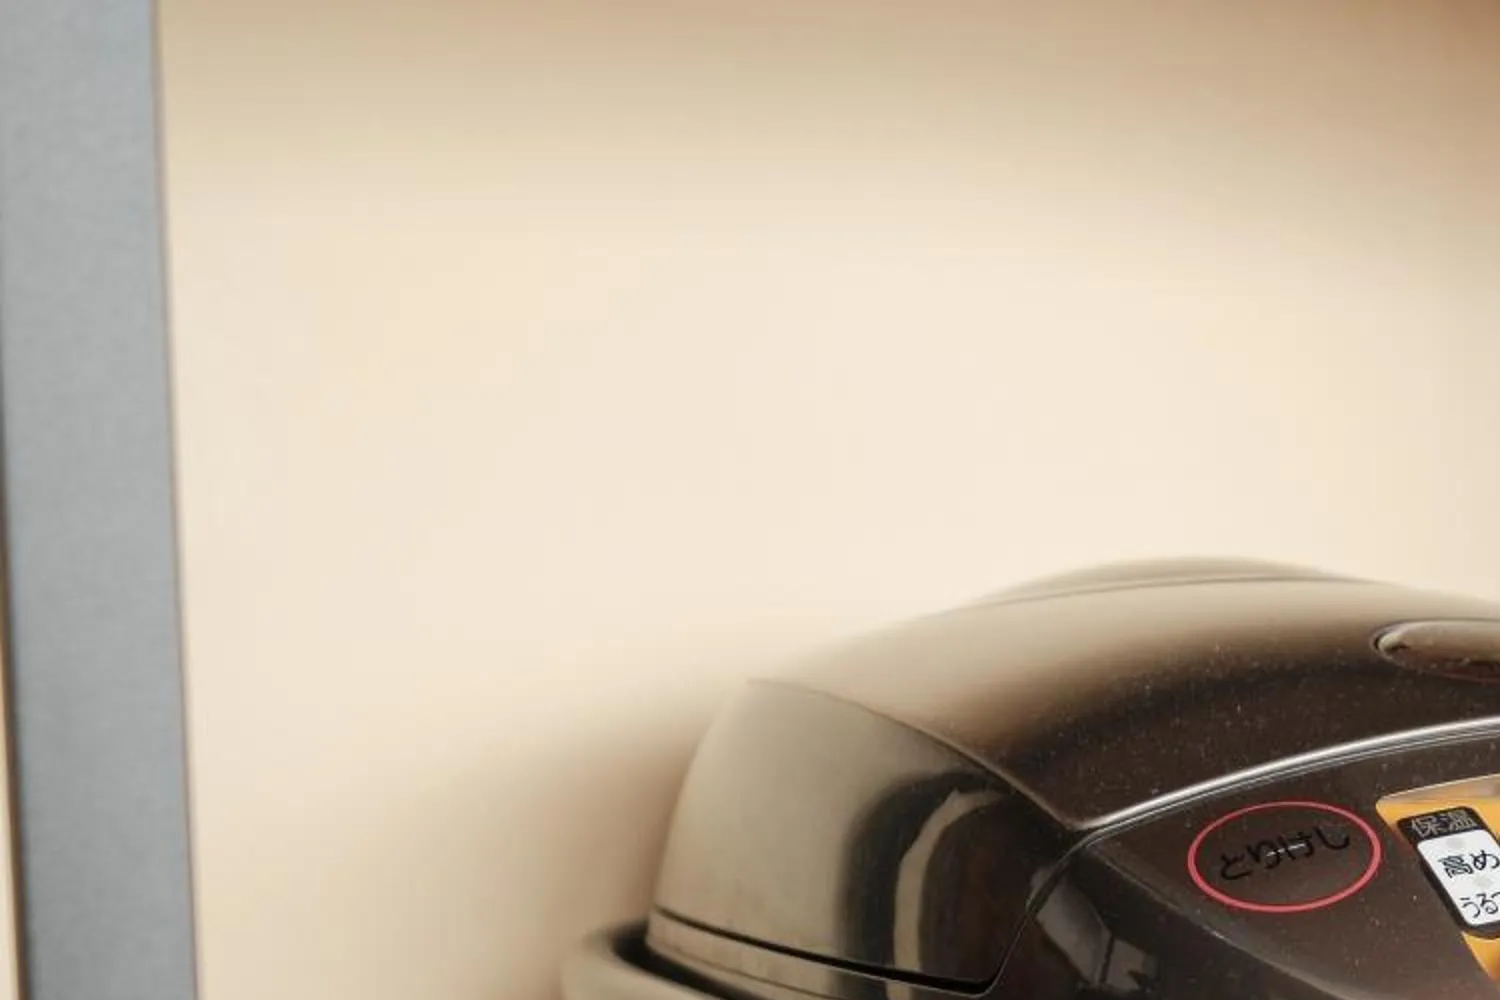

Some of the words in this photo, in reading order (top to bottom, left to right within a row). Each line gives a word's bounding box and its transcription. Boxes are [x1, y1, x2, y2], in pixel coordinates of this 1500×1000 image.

[1410, 810, 1477, 838] 保温
[1220, 826, 1350, 880] とりけし
[1438, 850, 1500, 878] 高め
